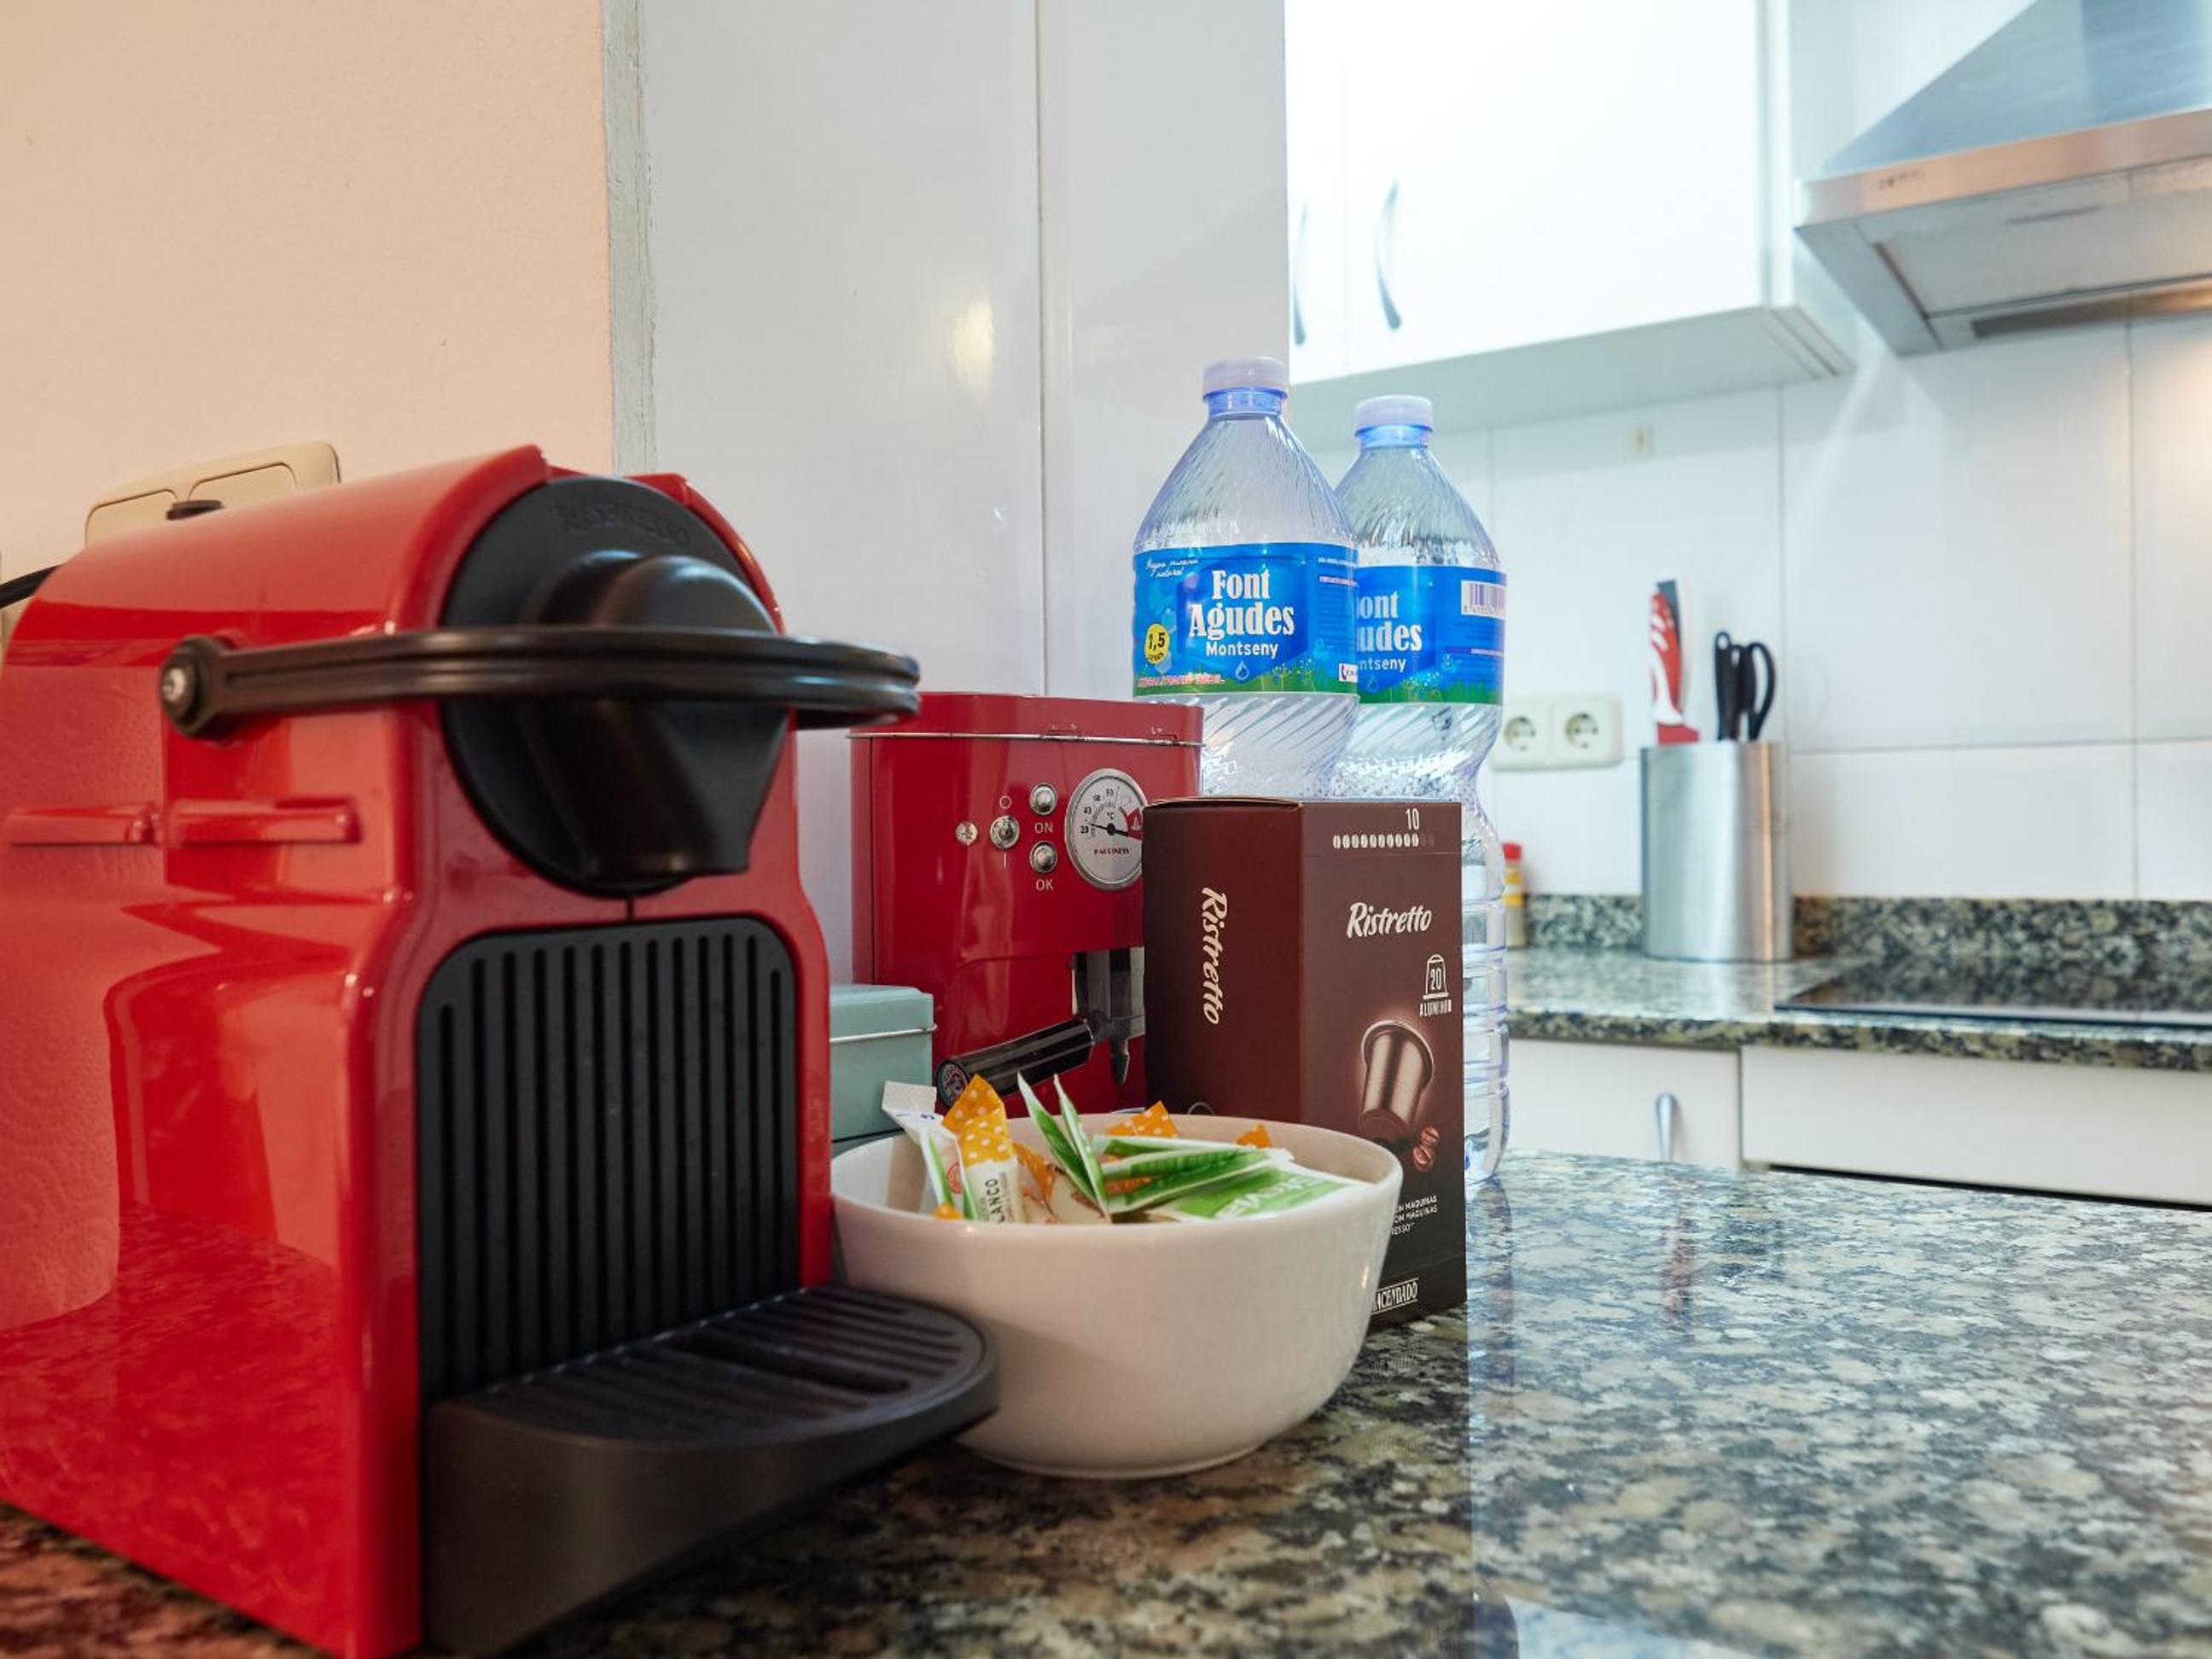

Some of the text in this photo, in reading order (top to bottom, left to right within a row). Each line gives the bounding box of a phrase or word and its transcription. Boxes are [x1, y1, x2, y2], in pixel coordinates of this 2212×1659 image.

[1211, 569, 1271, 601] Font
[1358, 591, 1399, 620] ont
[1187, 602, 1295, 641] Agudes
[1148, 632, 1166, 652] 1,5
[1357, 620, 1423, 652] udes
[1205, 641, 1278, 660] Montseny
[1359, 656, 1406, 673] ntseny
[1033, 821, 1054, 834] ON
[1406, 807, 1420, 830] 10
[1035, 878, 1055, 892] OK
[1346, 901, 1433, 940] Ristretto
[1201, 887, 1228, 1025] Ristretto
[1429, 967, 1441, 991] 20
[1377, 1281, 1418, 1311] ACENDADO
